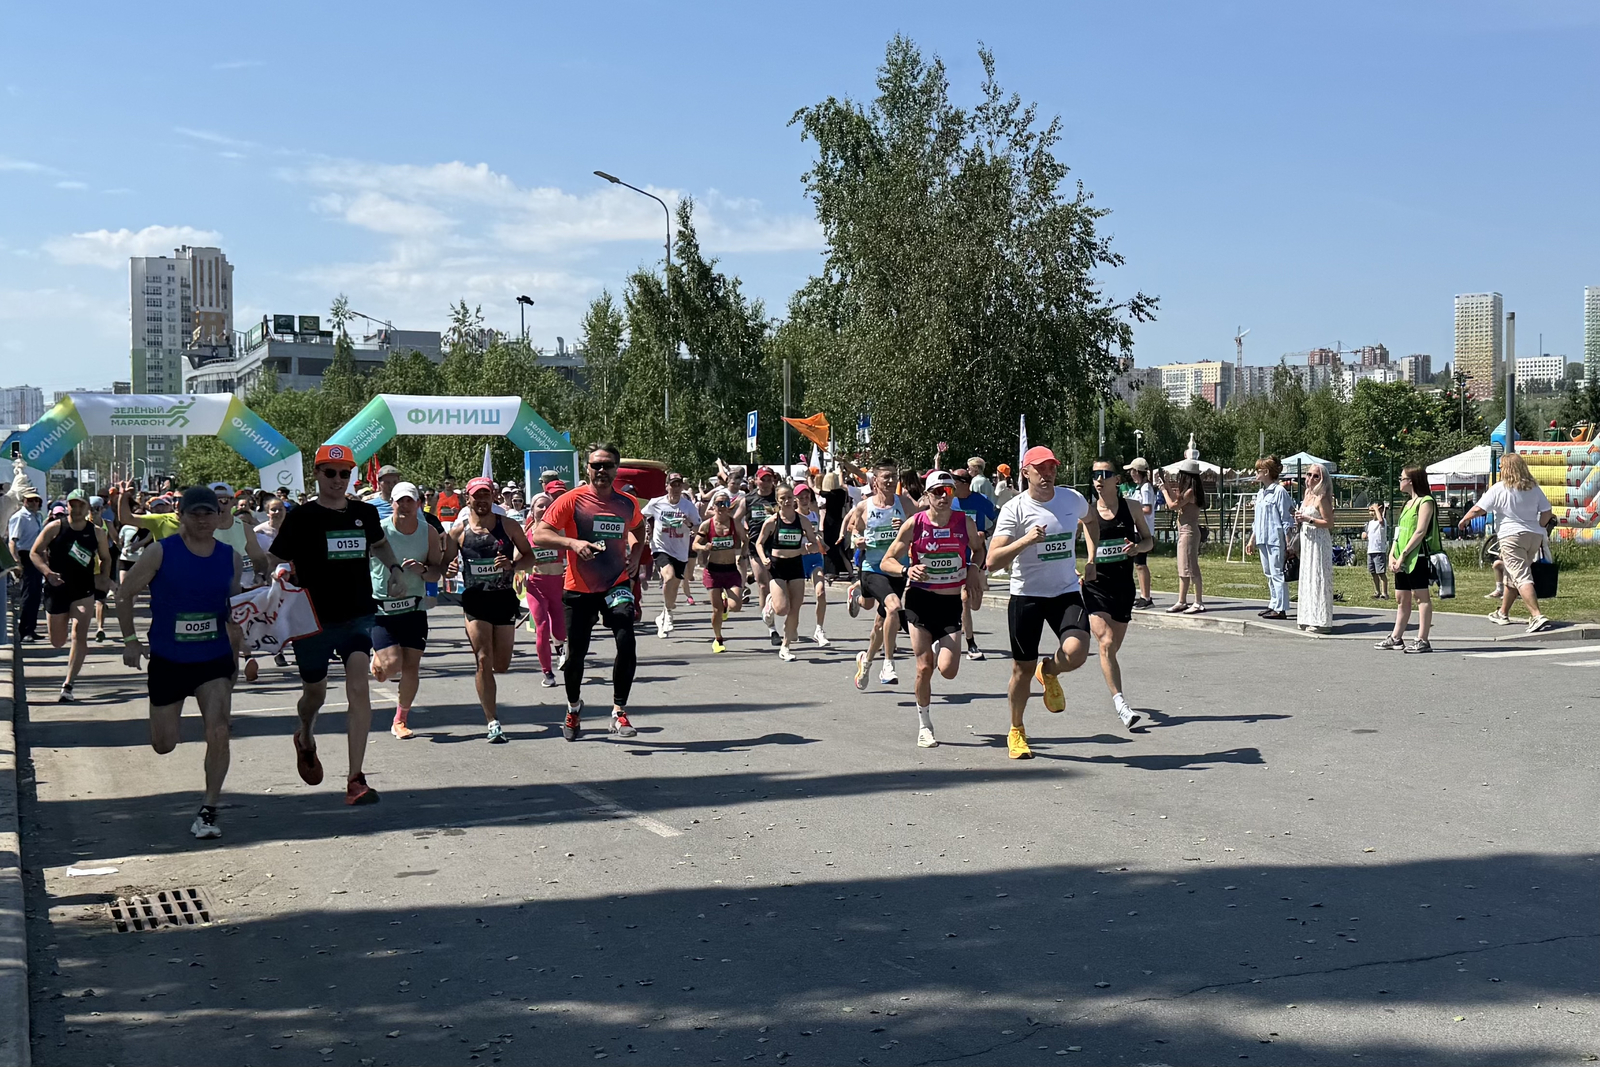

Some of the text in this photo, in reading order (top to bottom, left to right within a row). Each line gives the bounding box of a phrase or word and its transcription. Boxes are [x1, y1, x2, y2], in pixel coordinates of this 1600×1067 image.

[407, 408, 500, 424] ФИНИШ
[748, 414, 756, 436] P
[27, 417, 76, 460] ФИНИШ
[231, 417, 279, 457] ФИНИШ
[348, 418, 380, 448] зелёный
[353, 425, 385, 454] марафон
[523, 425, 552, 450] марафо
[528, 420, 559, 448] зелёный
[600, 523, 620, 531] 0606
[337, 540, 359, 549] 0135
[1045, 542, 1067, 551] 0525
[931, 559, 952, 567] 0708
[185, 621, 211, 632] 0058
